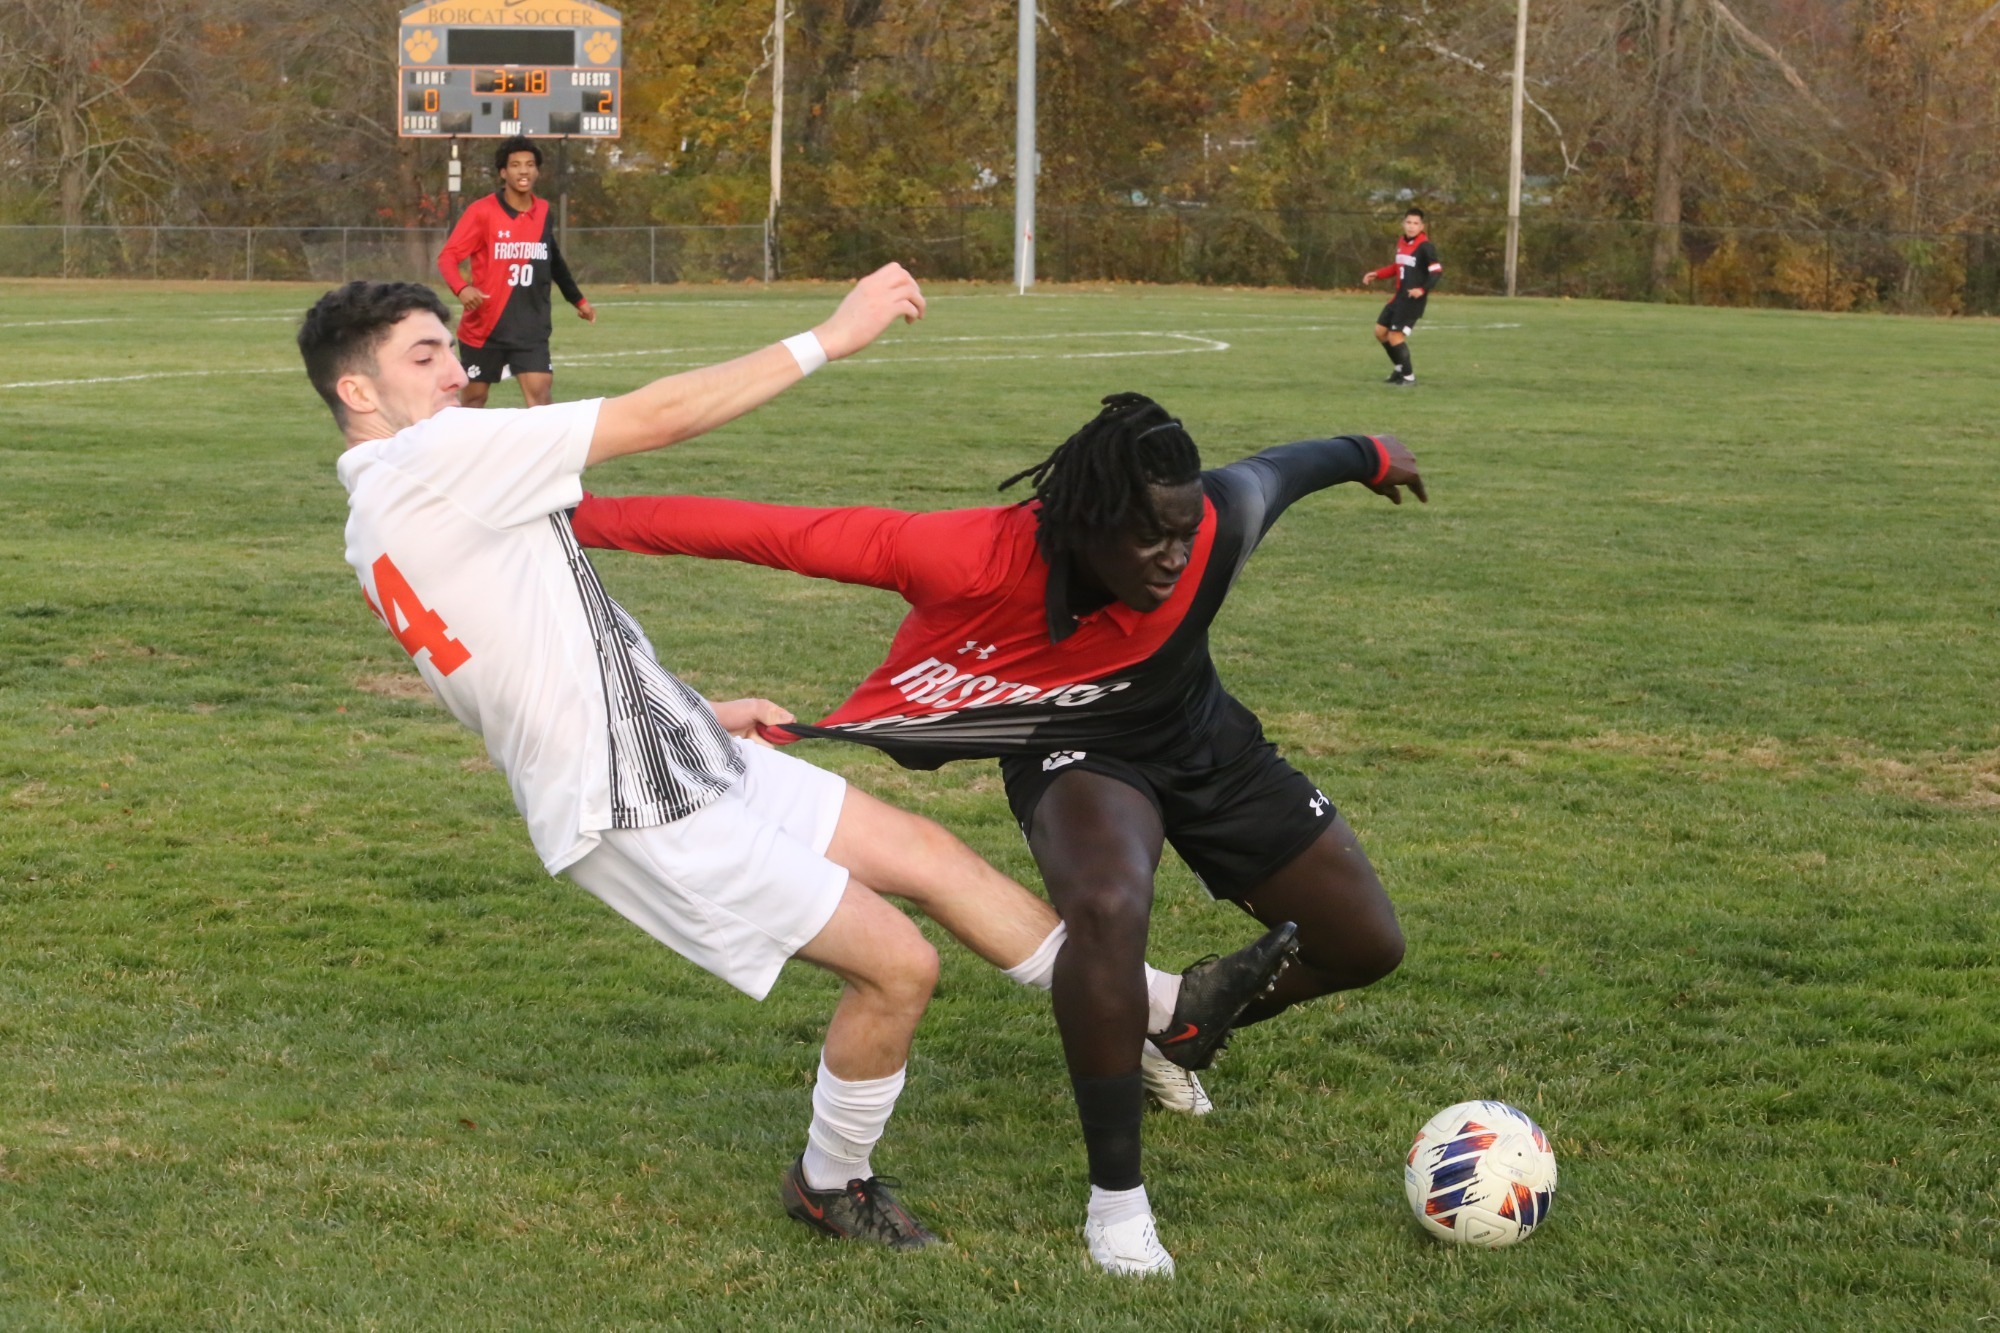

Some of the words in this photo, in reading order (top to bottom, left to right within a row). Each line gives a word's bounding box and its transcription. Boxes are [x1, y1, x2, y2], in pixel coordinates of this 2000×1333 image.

[428, 8, 510, 24] BOBCAT
[514, 8, 593, 25] SOCCER
[415, 71, 446, 85] HOME
[493, 69, 545, 93] 3:18
[571, 72, 611, 86] GUESTS
[424, 89, 439, 112] 0
[598, 90, 613, 113] 2
[403, 116, 438, 129] SHOTS
[500, 121, 521, 135] HALF
[583, 117, 618, 131] SHOTS
[494, 242, 548, 260] FROSTBURG
[507, 264, 534, 287] 30
